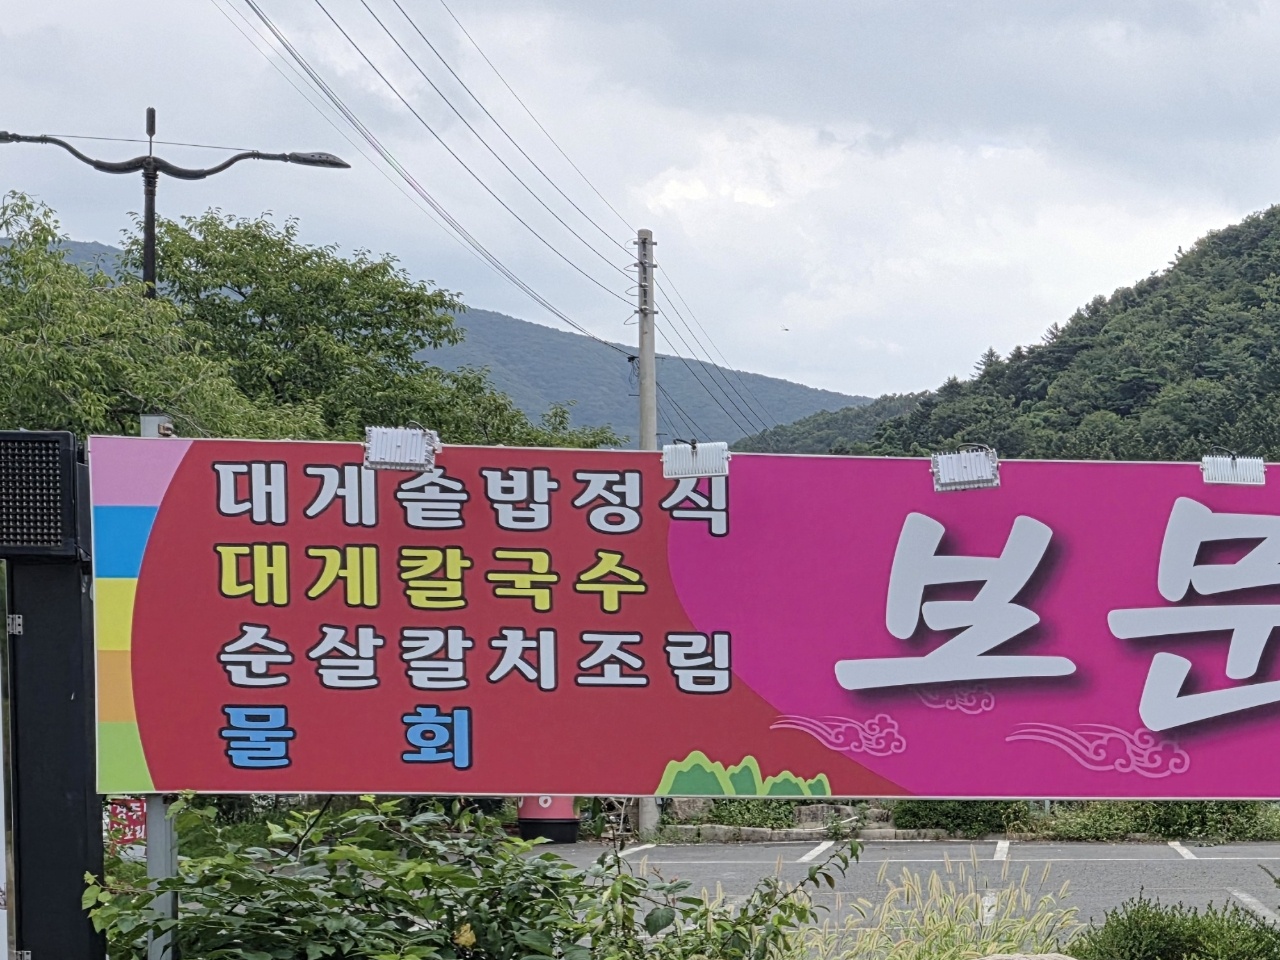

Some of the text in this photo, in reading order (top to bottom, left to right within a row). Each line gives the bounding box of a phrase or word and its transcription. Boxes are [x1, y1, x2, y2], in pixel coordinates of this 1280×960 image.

[212, 461, 730, 537] 대게솥밥정식
[213, 542, 648, 613] 대게칼국수
[217, 622, 732, 694] 순살칼치조림
